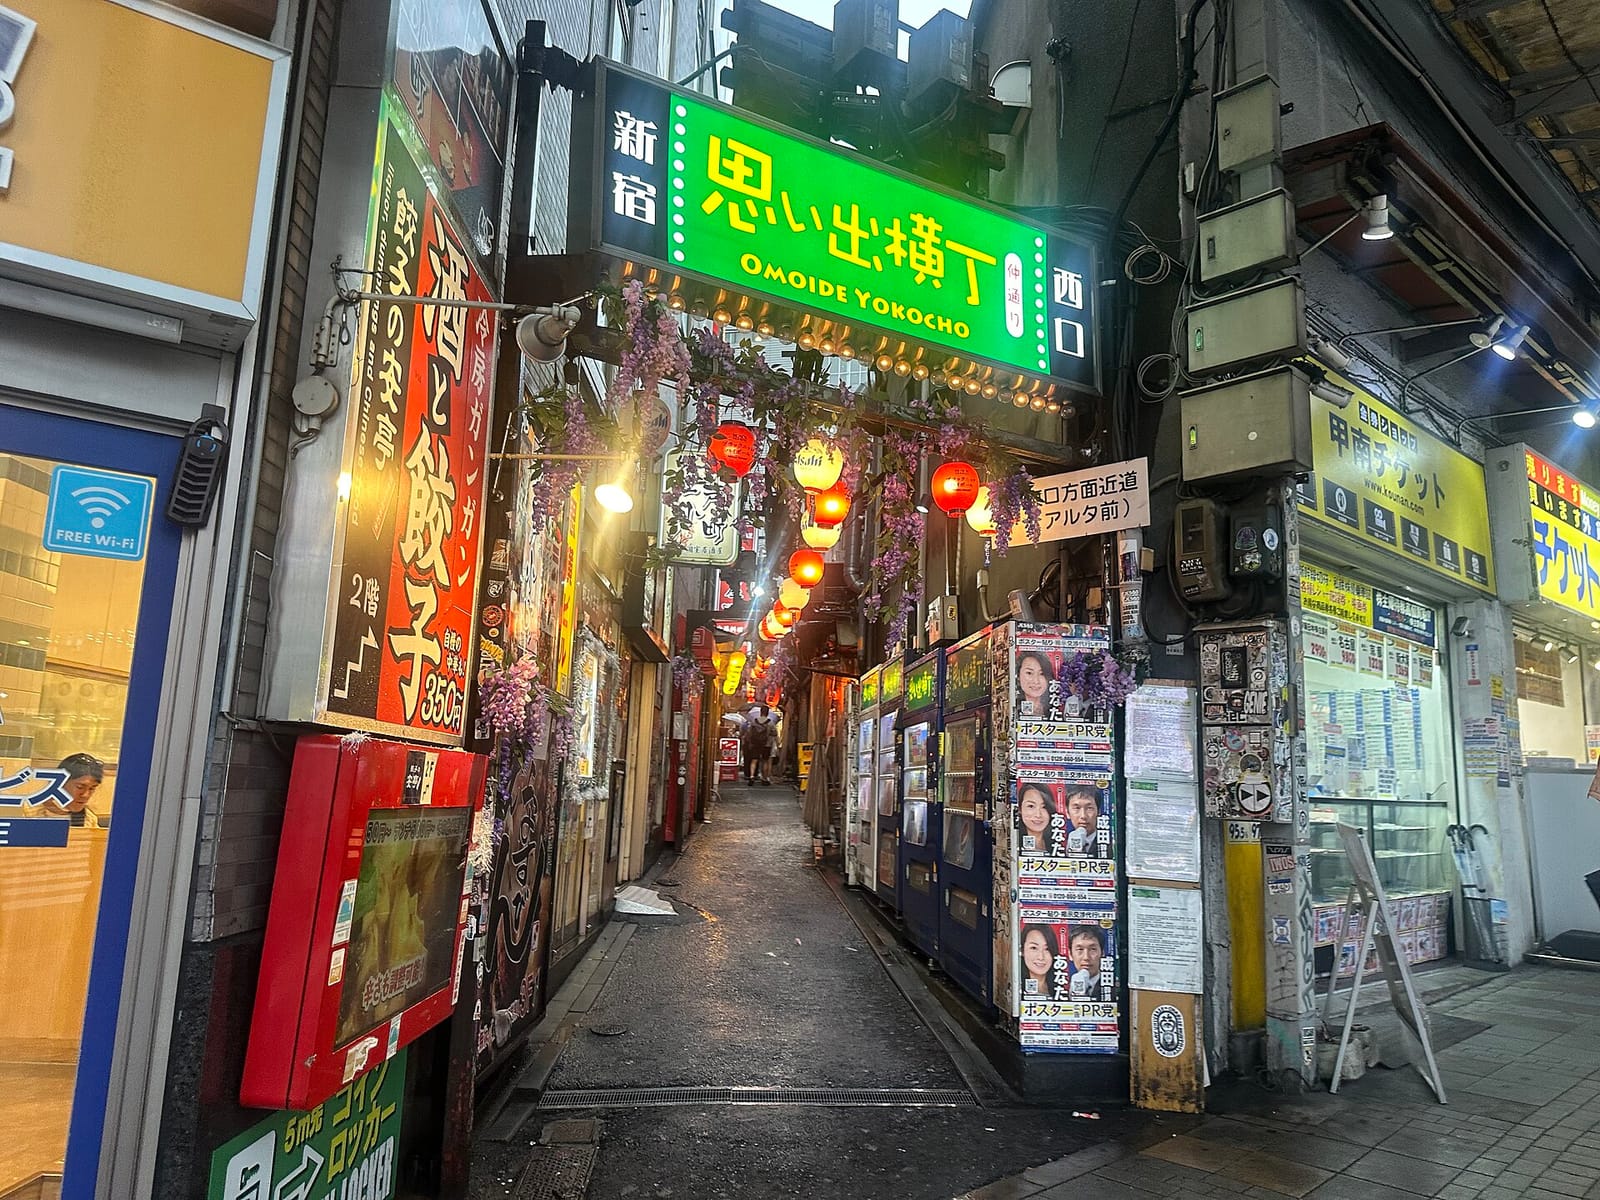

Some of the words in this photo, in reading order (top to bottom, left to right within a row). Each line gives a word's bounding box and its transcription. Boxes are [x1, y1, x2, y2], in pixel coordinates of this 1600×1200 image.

[613, 109, 657, 226] 新宿
[700, 134, 998, 307] 思い出横丁
[739, 252, 848, 303] OMOIDE
[854, 286, 971, 339] YOKOCHO
[1006, 262, 1023, 328] 仲通り
[1053, 265, 1086, 359] 西口
[389, 207, 470, 722] 酒と餃子
[1037, 470, 1138, 504] 口方面近道
[1329, 411, 1446, 509] 甲南チケット
[1526, 453, 1580, 503] 売ります
[1528, 479, 1581, 528] 買います
[56, 529, 92, 546] FREE
[95, 533, 135, 550] Wi-Fi
[1534, 519, 1600, 608] チケット
[350, 572, 380, 618] 2階
[1049, 680, 1063, 721] あなた
[1051, 813, 1065, 857] あなた
[1053, 955, 1068, 1000] あなた
[332, 1060, 389, 1127] コイン
[327, 1100, 396, 1184] ロッカー
